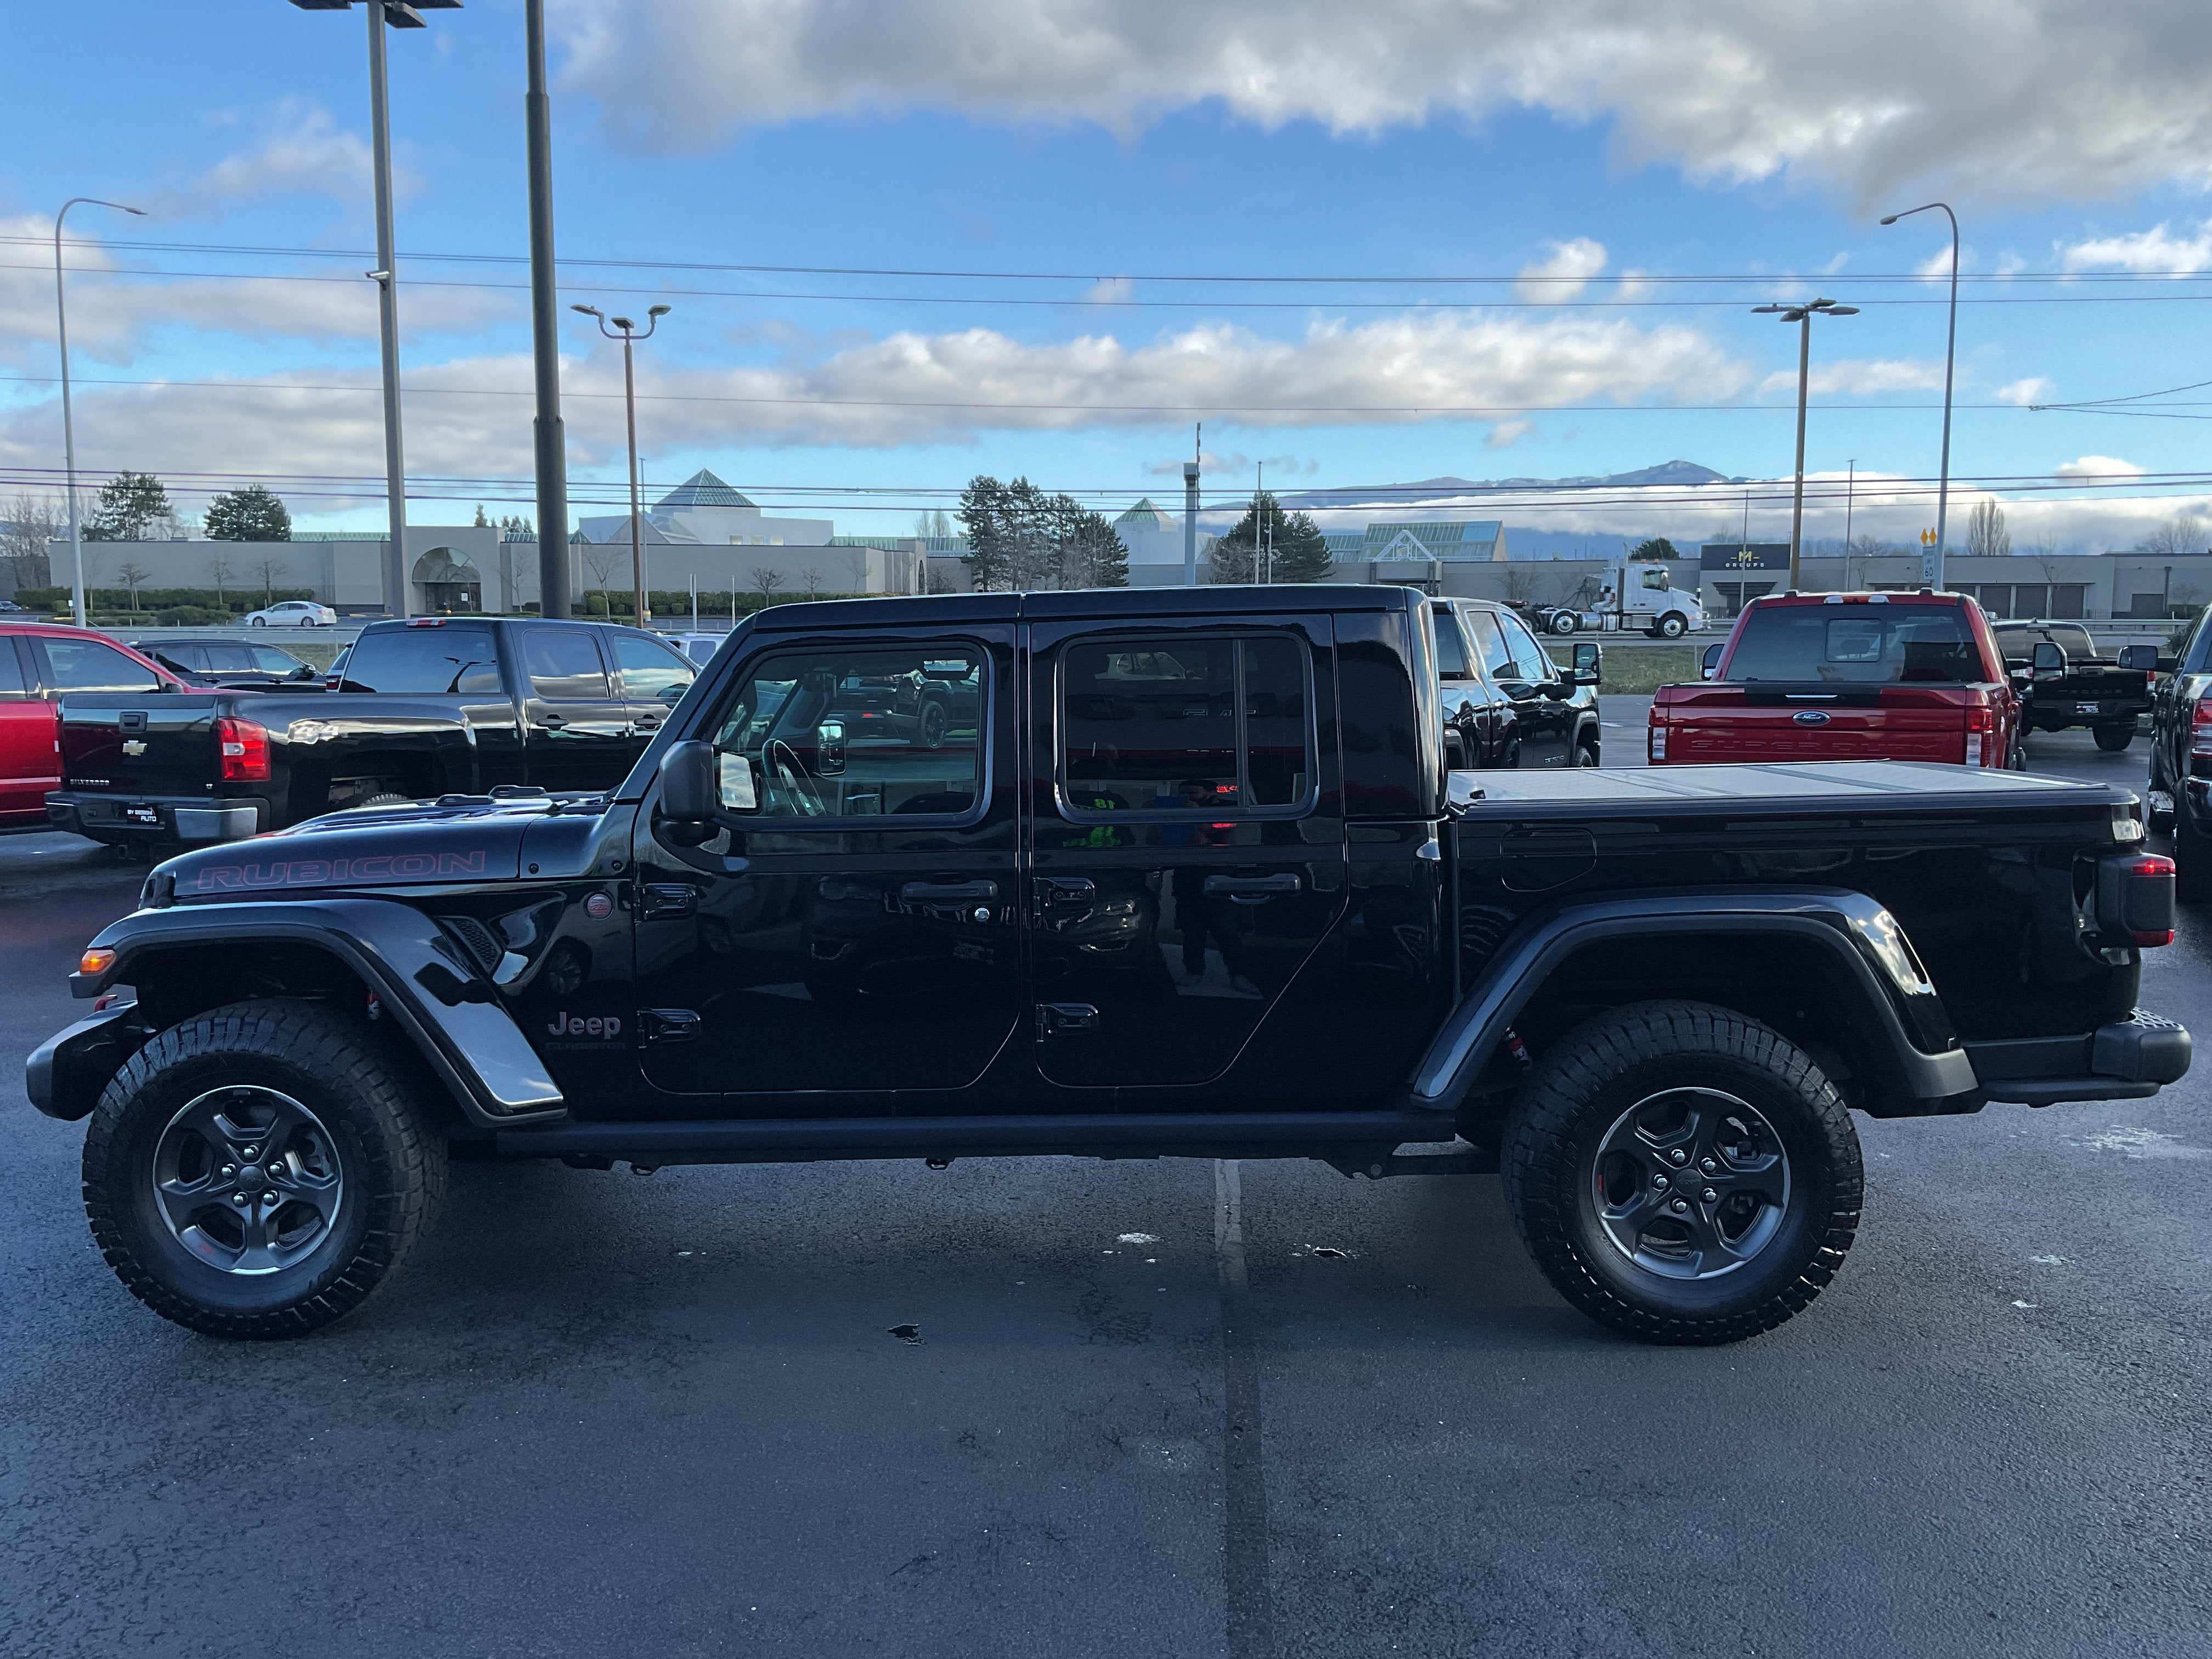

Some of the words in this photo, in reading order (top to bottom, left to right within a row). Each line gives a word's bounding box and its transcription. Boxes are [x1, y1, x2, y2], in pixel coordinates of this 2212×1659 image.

[1925, 567, 1933, 577] 60
[198, 851, 486, 889] RUBICON
[548, 1012, 621, 1039] Jeep
